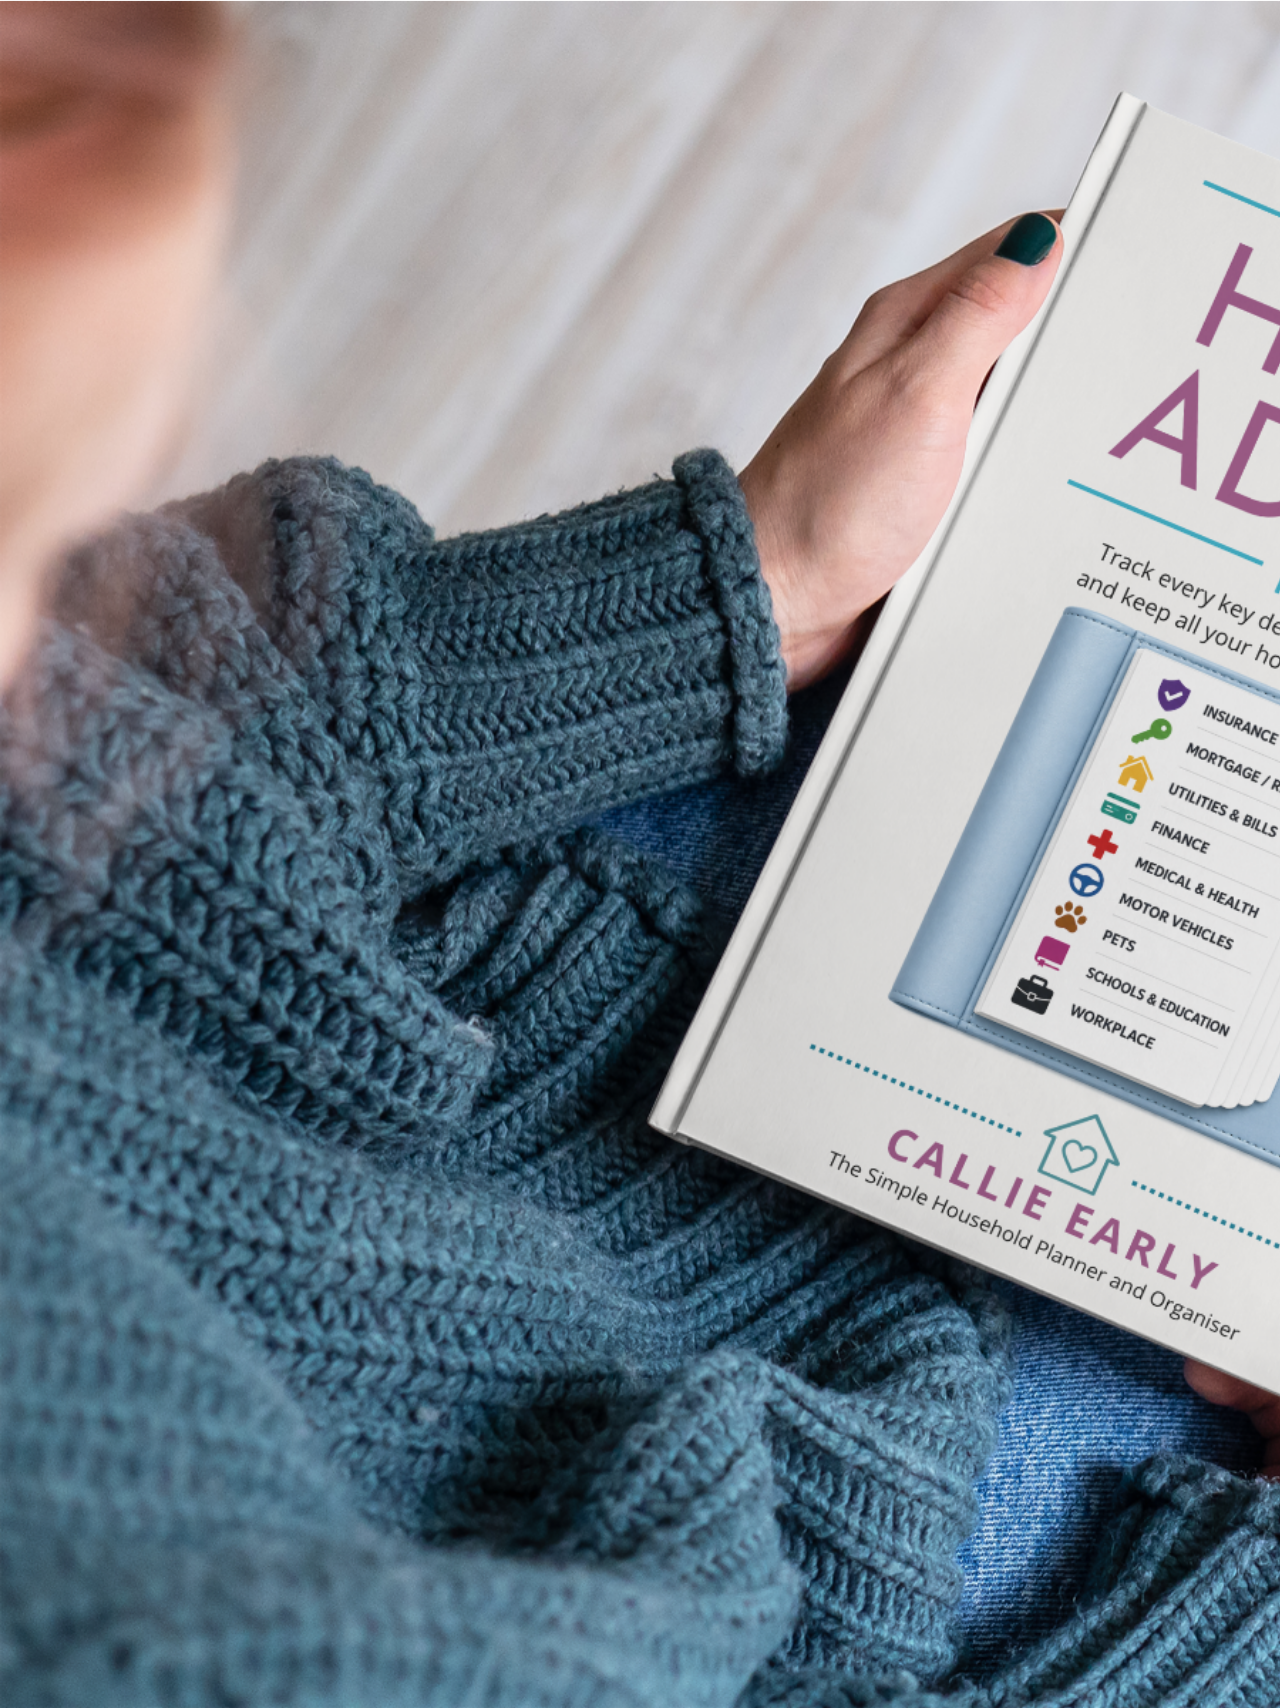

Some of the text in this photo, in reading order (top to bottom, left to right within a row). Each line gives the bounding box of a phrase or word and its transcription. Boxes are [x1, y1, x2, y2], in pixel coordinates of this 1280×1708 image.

[1100, 541, 1156, 582] Track
[1157, 572, 1217, 610] every
[1216, 592, 1256, 626] key
[1075, 572, 1120, 600] and
[1119, 585, 1171, 625] keep
[1173, 613, 1203, 635] all
[1198, 624, 1253, 656] your
[1201, 703, 1280, 746] INSURANCE
[1184, 741, 1262, 784] MORTGAGE
[1259, 774, 1272, 787] /
[1149, 819, 1211, 855] FINANCE
[1167, 781, 1279, 838] UTILITIES & BILLS
[1133, 855, 1260, 919] MEDICAL & HEALTH
[1101, 928, 1137, 953] PETS
[1118, 891, 1235, 951] MOTOR VEHICLES
[1069, 1002, 1156, 1050] WORKPLACE
[1084, 966, 1231, 1038] SCHOOLS & EDUCATION
[886, 1128, 1219, 1290] CALLIE EARLY
[828, 1149, 1241, 1341] The Simple Household Planner and Organiser
